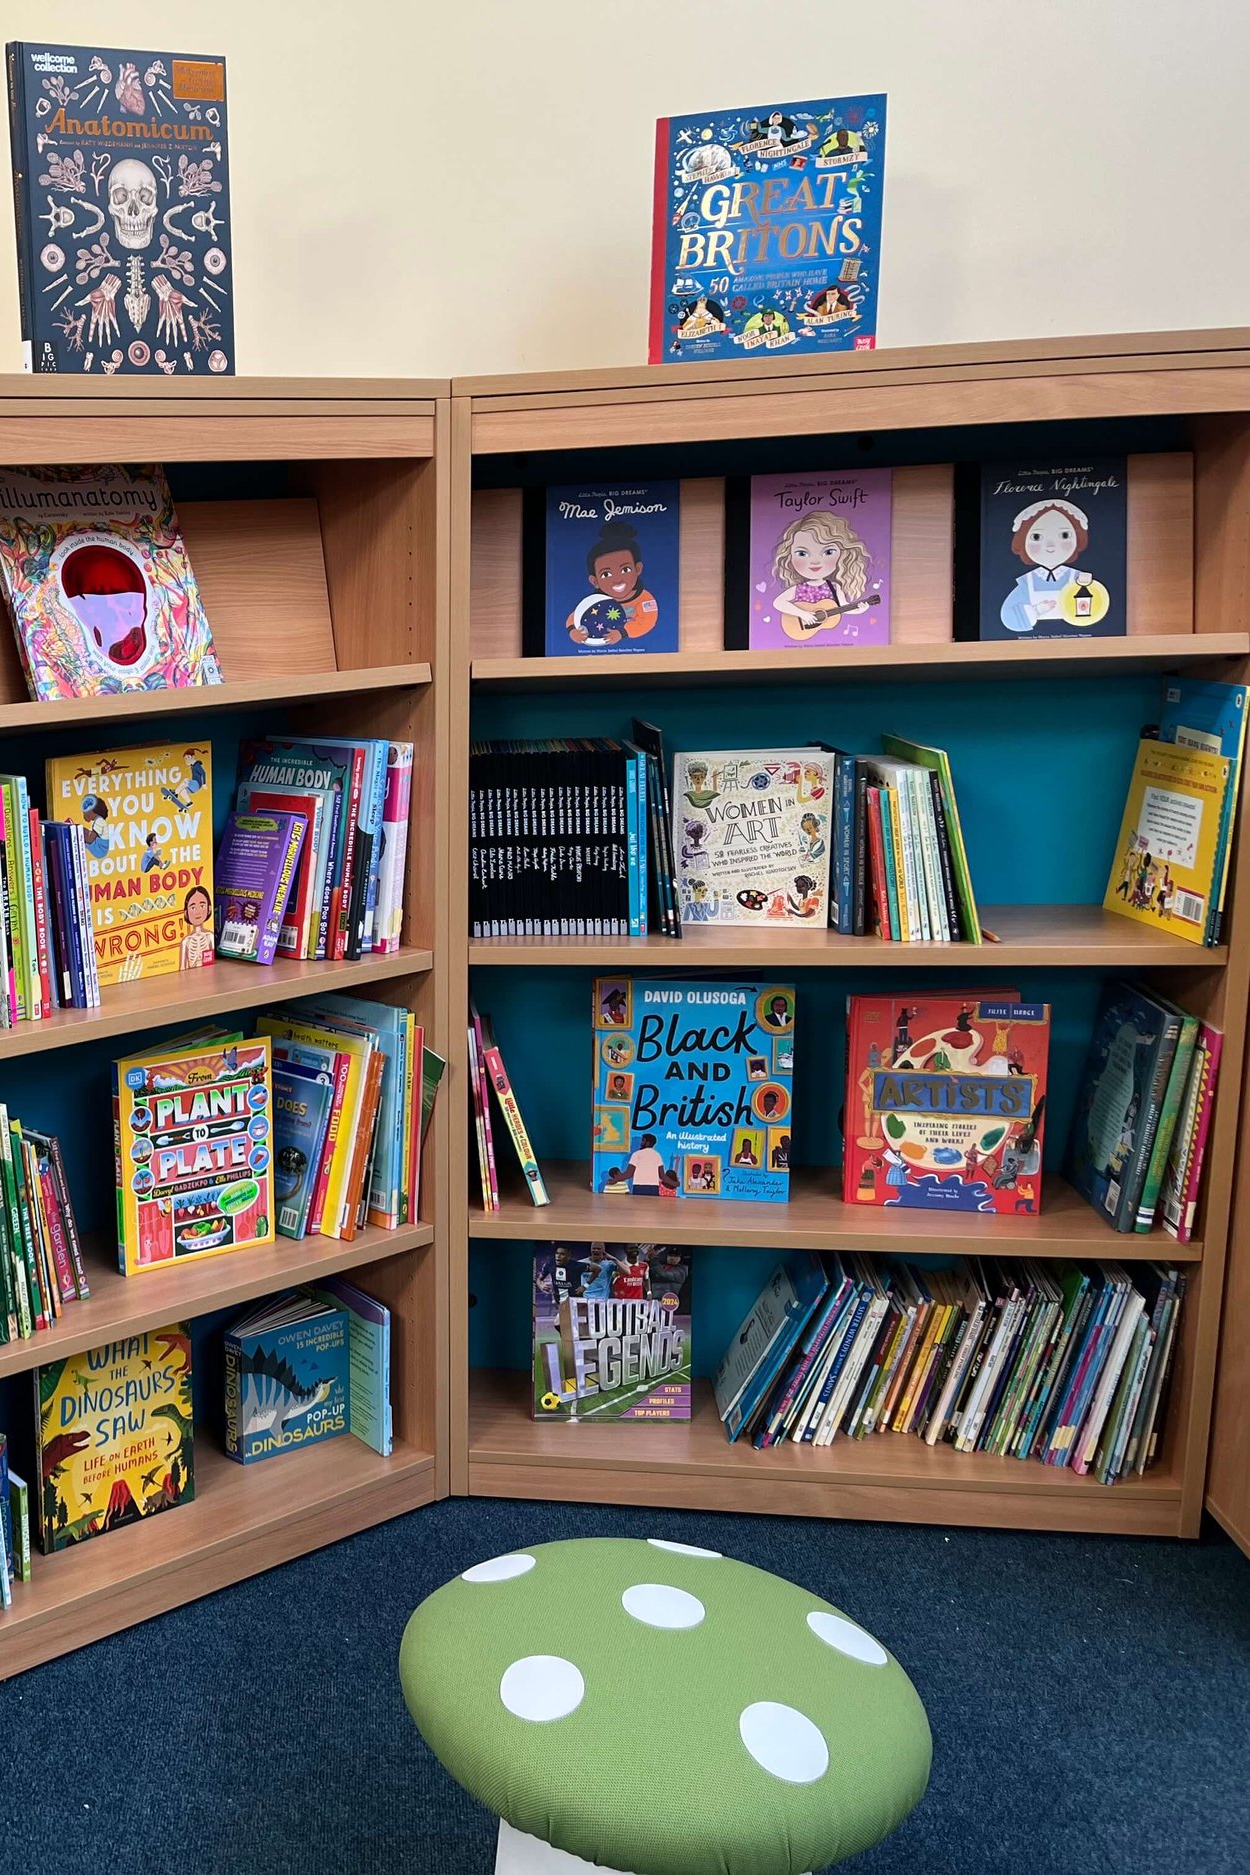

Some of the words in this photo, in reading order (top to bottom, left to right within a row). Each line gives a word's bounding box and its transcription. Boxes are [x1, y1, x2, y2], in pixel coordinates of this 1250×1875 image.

[31, 53, 75, 64] wellcome
[34, 62, 78, 73] collection
[45, 108, 214, 141] Anatomicum
[701, 172, 847, 228] GREAT
[676, 215, 862, 276] BRITONS
[709, 277, 729, 294] 50
[992, 479, 1044, 496] Florence
[1049, 475, 1120, 497] Nightingale
[559, 500, 598, 519] Mae
[604, 499, 667, 522] Jemison
[773, 491, 825, 513] Taylor
[828, 487, 869, 509] Swift
[282, 758, 313, 766] INCREDIBLE
[62, 766, 182, 798] EVERYTHING
[250, 764, 296, 785] HUMAN
[296, 768, 332, 790] BODY
[107, 792, 154, 817] YOU
[705, 797, 782, 823] WOMEN
[785, 799, 795, 807] IN
[108, 811, 201, 851] KNOW
[723, 817, 781, 845] ART
[170, 845, 201, 862] THE
[727, 847, 757, 856] FEARLESS
[760, 842, 792, 851] CREATIVES
[730, 855, 758, 864] INSPIRED
[773, 849, 797, 857] WORLD
[149, 866, 204, 892] BODY
[35, 885, 43, 901] THE
[37, 902, 45, 926] BODY
[97, 908, 114, 925] IS
[39, 927, 47, 950] BOOK
[263, 934, 277, 943] ADAM
[264, 940, 274, 948] KAY
[644, 990, 683, 1004] DAVID
[686, 991, 746, 1005] OLUSOGA
[636, 1011, 758, 1062] Black
[130, 1074, 142, 1083] DK
[188, 1072, 213, 1084] From
[665, 1061, 731, 1081] AND
[157, 1084, 249, 1128] PLANT
[631, 1084, 754, 1131] British
[196, 1128, 205, 1138] TO
[328, 1108, 341, 1142] FOOD
[666, 1131, 677, 1140] An
[678, 1131, 727, 1143] illustrated
[677, 1140, 710, 1153] history
[160, 1137, 247, 1181] PLATE
[569, 1297, 677, 1341] FOOTBALL
[852, 1305, 866, 1328] SISTER
[278, 1329, 312, 1346] OWEN
[314, 1320, 344, 1334] DAVEY
[109, 1366, 128, 1381] THE
[545, 1329, 686, 1403] LEGENDS
[60, 1365, 177, 1427] DINOSAURS
[823, 1374, 837, 1398] SAINTS
[225, 1354, 237, 1454] DINOSAURS
[307, 1404, 346, 1424] POP-UP
[95, 1408, 146, 1448] SAW
[251, 1415, 346, 1455] DINOSAURS
[83, 1456, 106, 1472] LIFE
[109, 1451, 121, 1463] ON
[123, 1437, 156, 1459] EARTH
[83, 1469, 112, 1485] BEFORE
[114, 1452, 159, 1475] HUMANS
